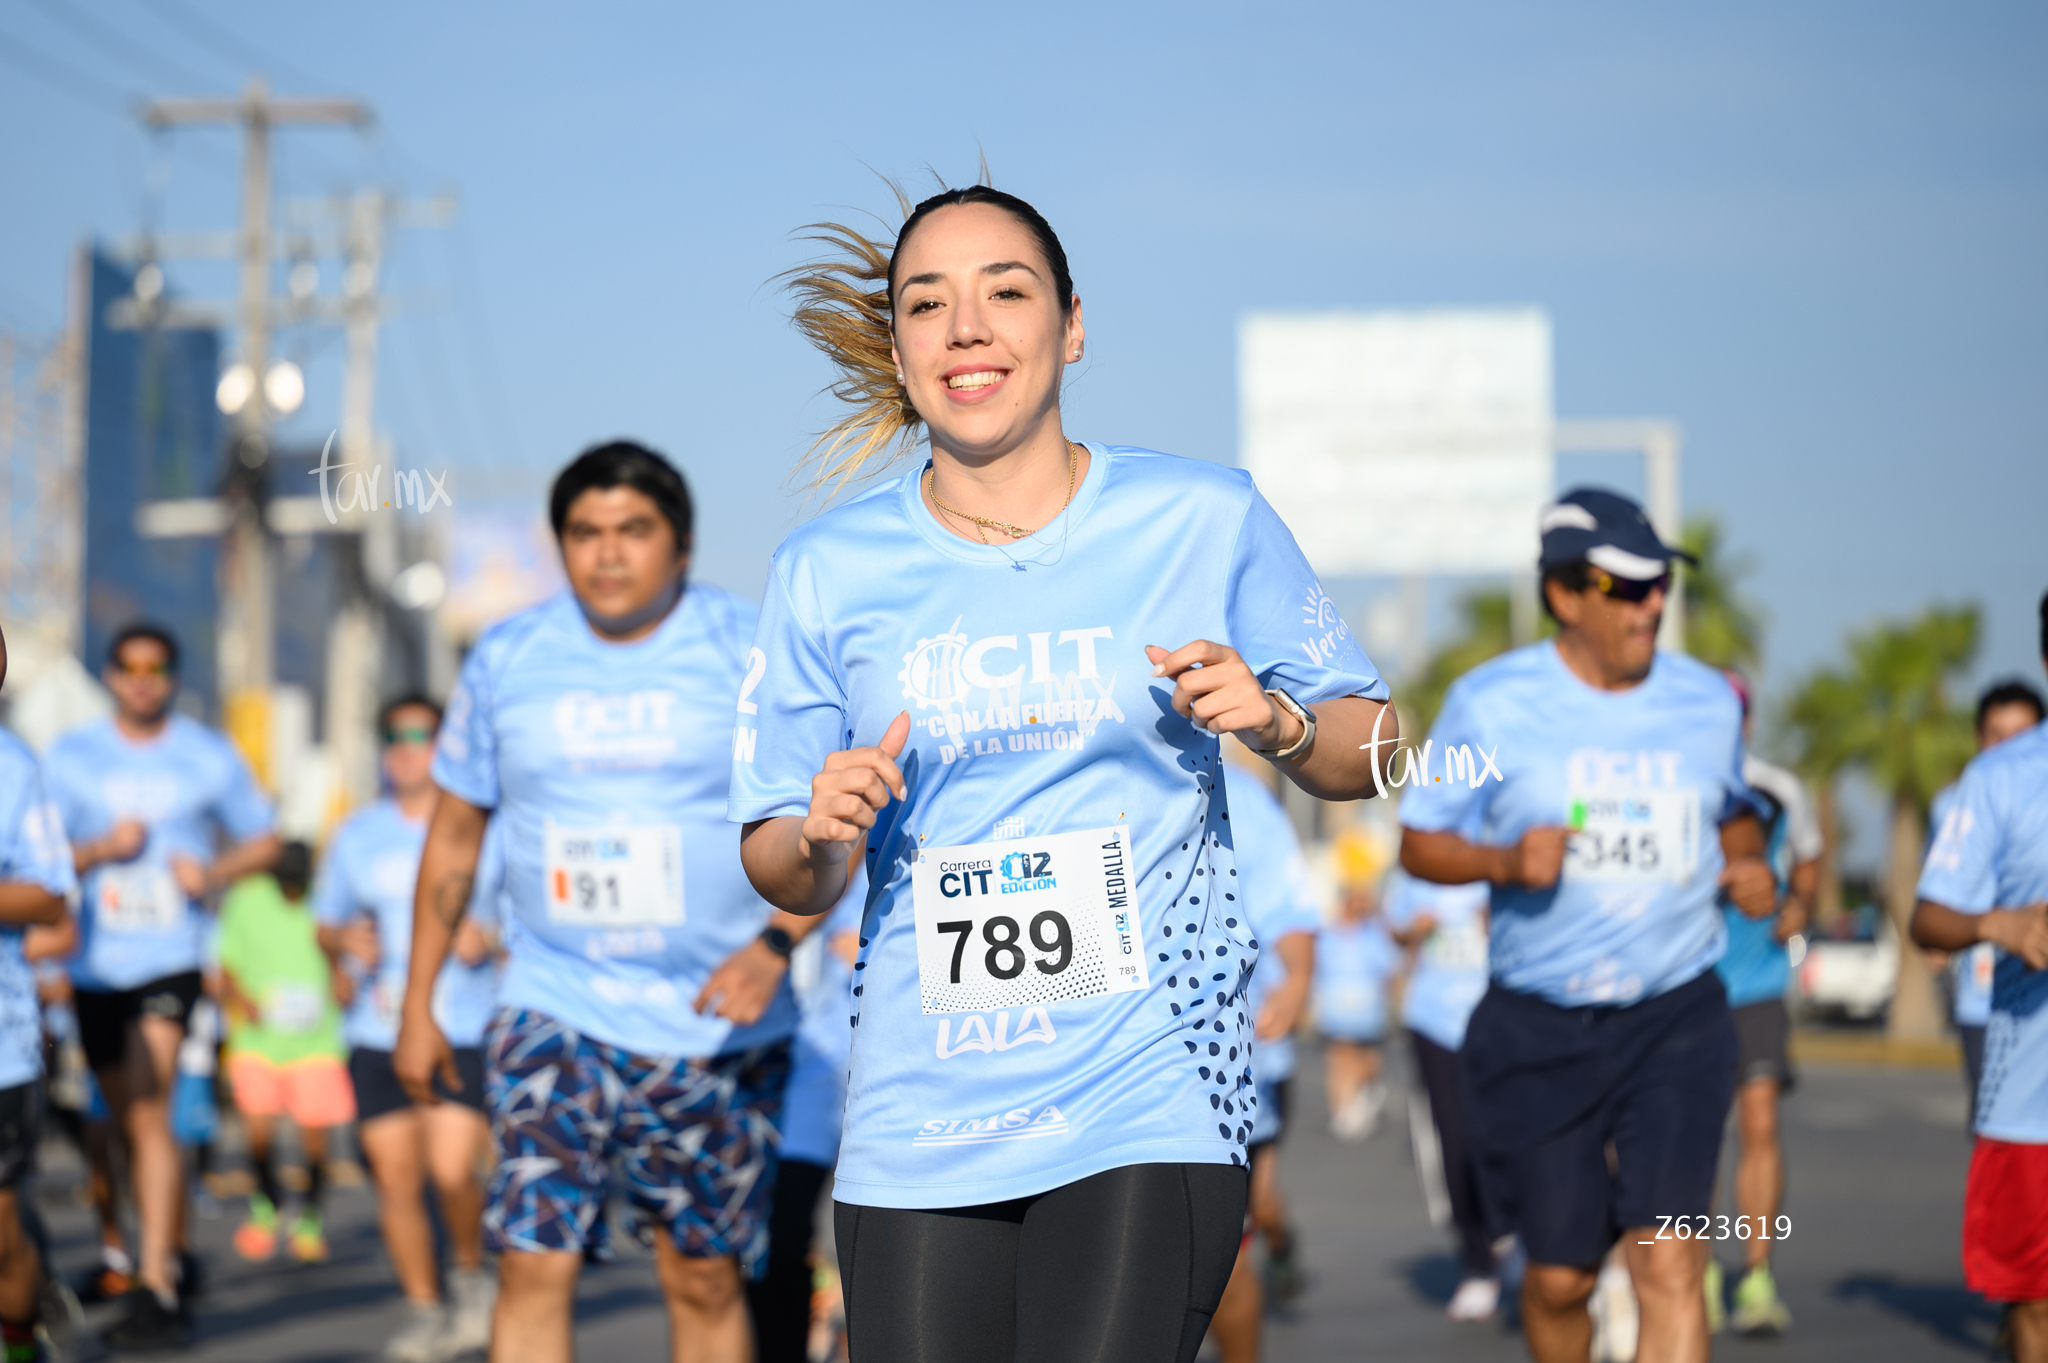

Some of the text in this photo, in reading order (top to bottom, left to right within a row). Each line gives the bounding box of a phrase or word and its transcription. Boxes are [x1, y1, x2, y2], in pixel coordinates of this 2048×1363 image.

[960, 626, 1114, 688] CIT
[1301, 631, 1337, 666] Ver
[987, 706, 1014, 730] LA
[1021, 698, 1113, 726] FUERZA
[939, 742, 970, 765] DE
[974, 737, 1004, 756] LA
[940, 860, 991, 872] Carrera
[1102, 840, 1128, 908] MEDALLA
[940, 869, 993, 898] CIT
[937, 910, 1074, 984] 789
[1123, 934, 1132, 955] CIT
[1119, 965, 1136, 975] 789
[936, 1006, 1057, 1060] LALA
[918, 1105, 1067, 1136] SIMSA
